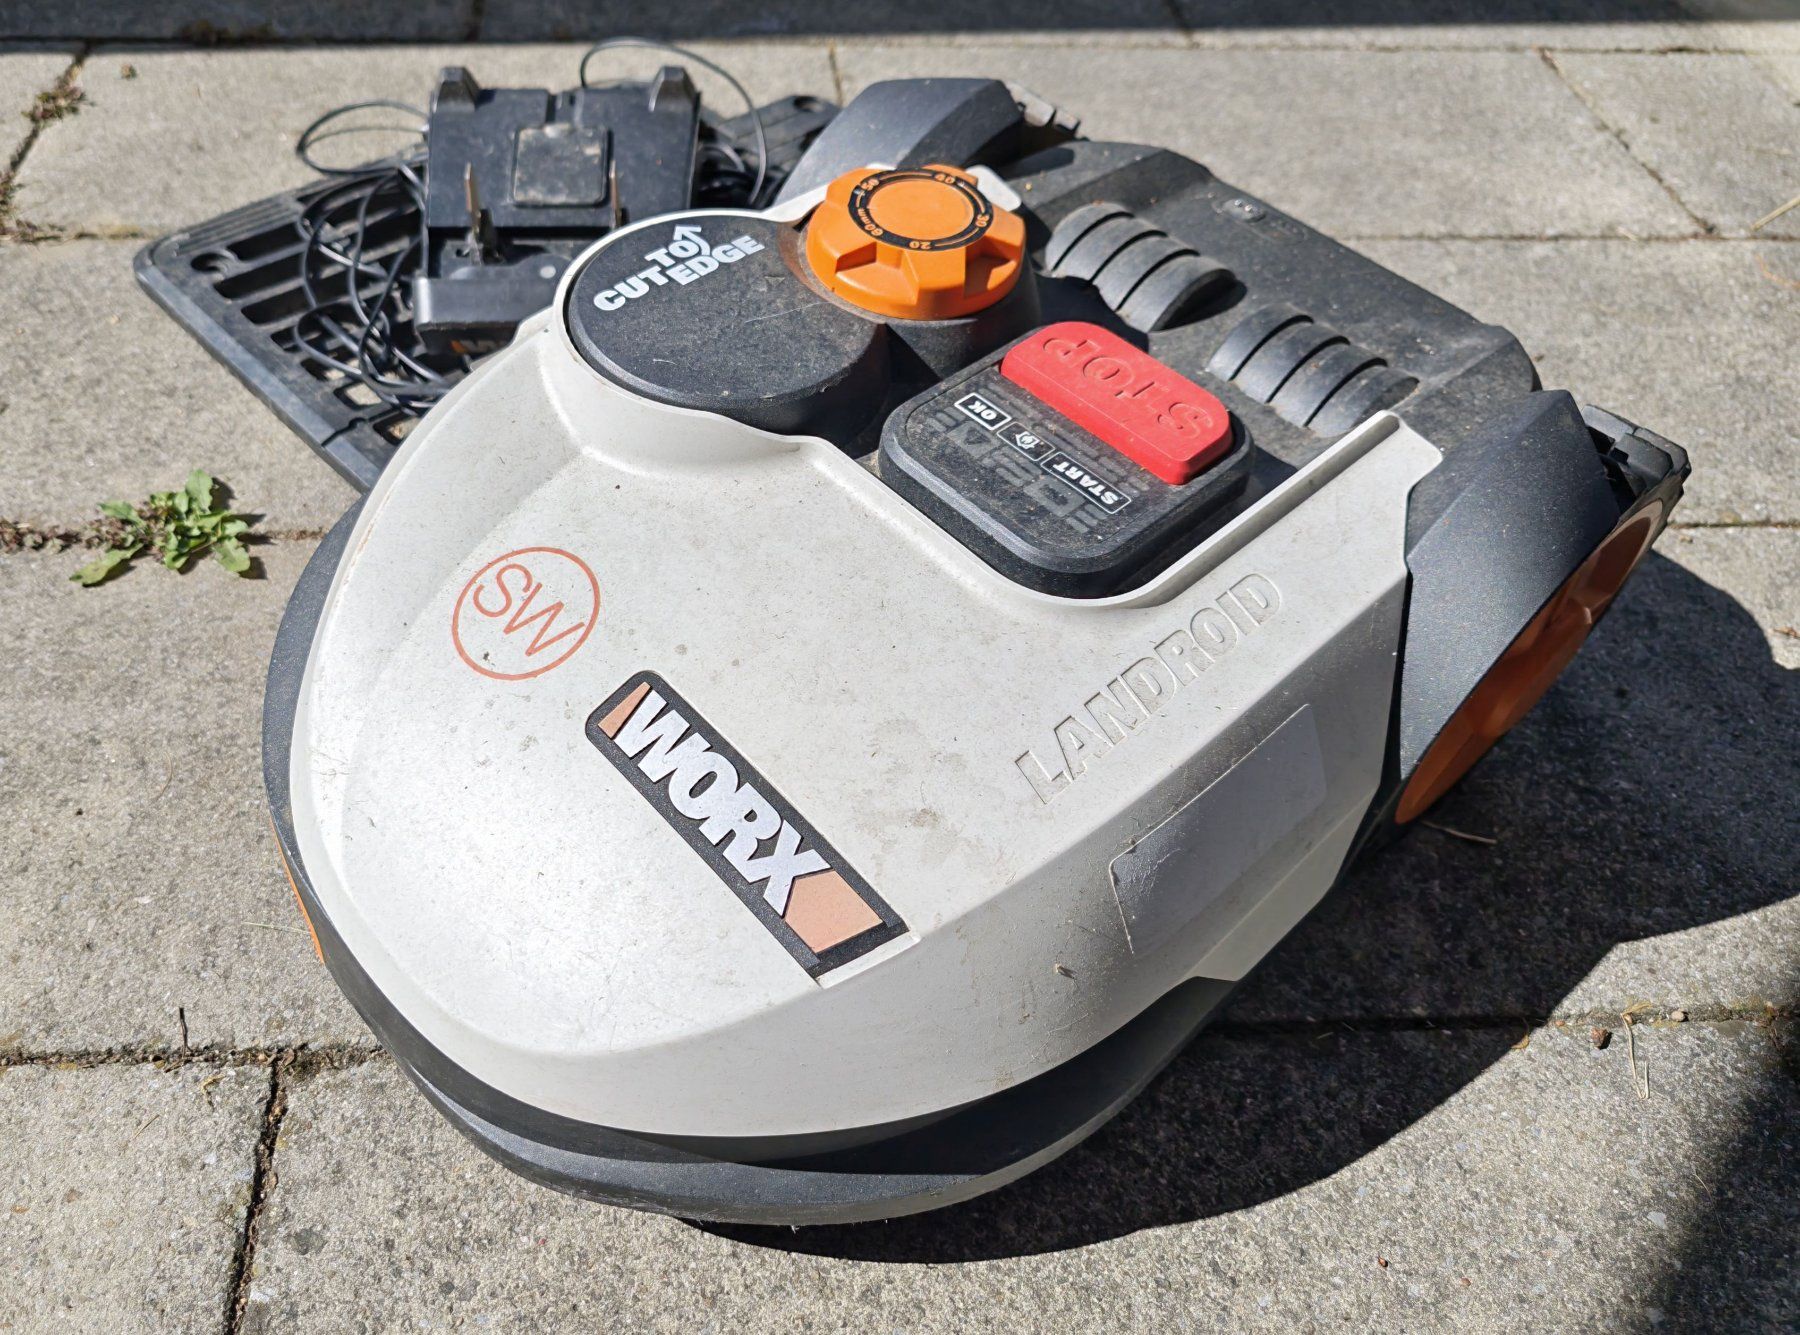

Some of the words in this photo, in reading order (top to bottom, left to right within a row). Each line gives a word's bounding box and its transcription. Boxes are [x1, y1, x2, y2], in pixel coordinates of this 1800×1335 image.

[645, 240, 700, 268] TO
[666, 235, 765, 286] EDGE
[909, 240, 931, 250] 20
[593, 266, 669, 311] CUT
[968, 400, 998, 420] OK
[1043, 336, 1215, 440] STOP
[1052, 460, 1120, 506] START
[473, 563, 585, 657] SW
[1015, 573, 1281, 804] LANDROID
[613, 690, 832, 918] WORX
